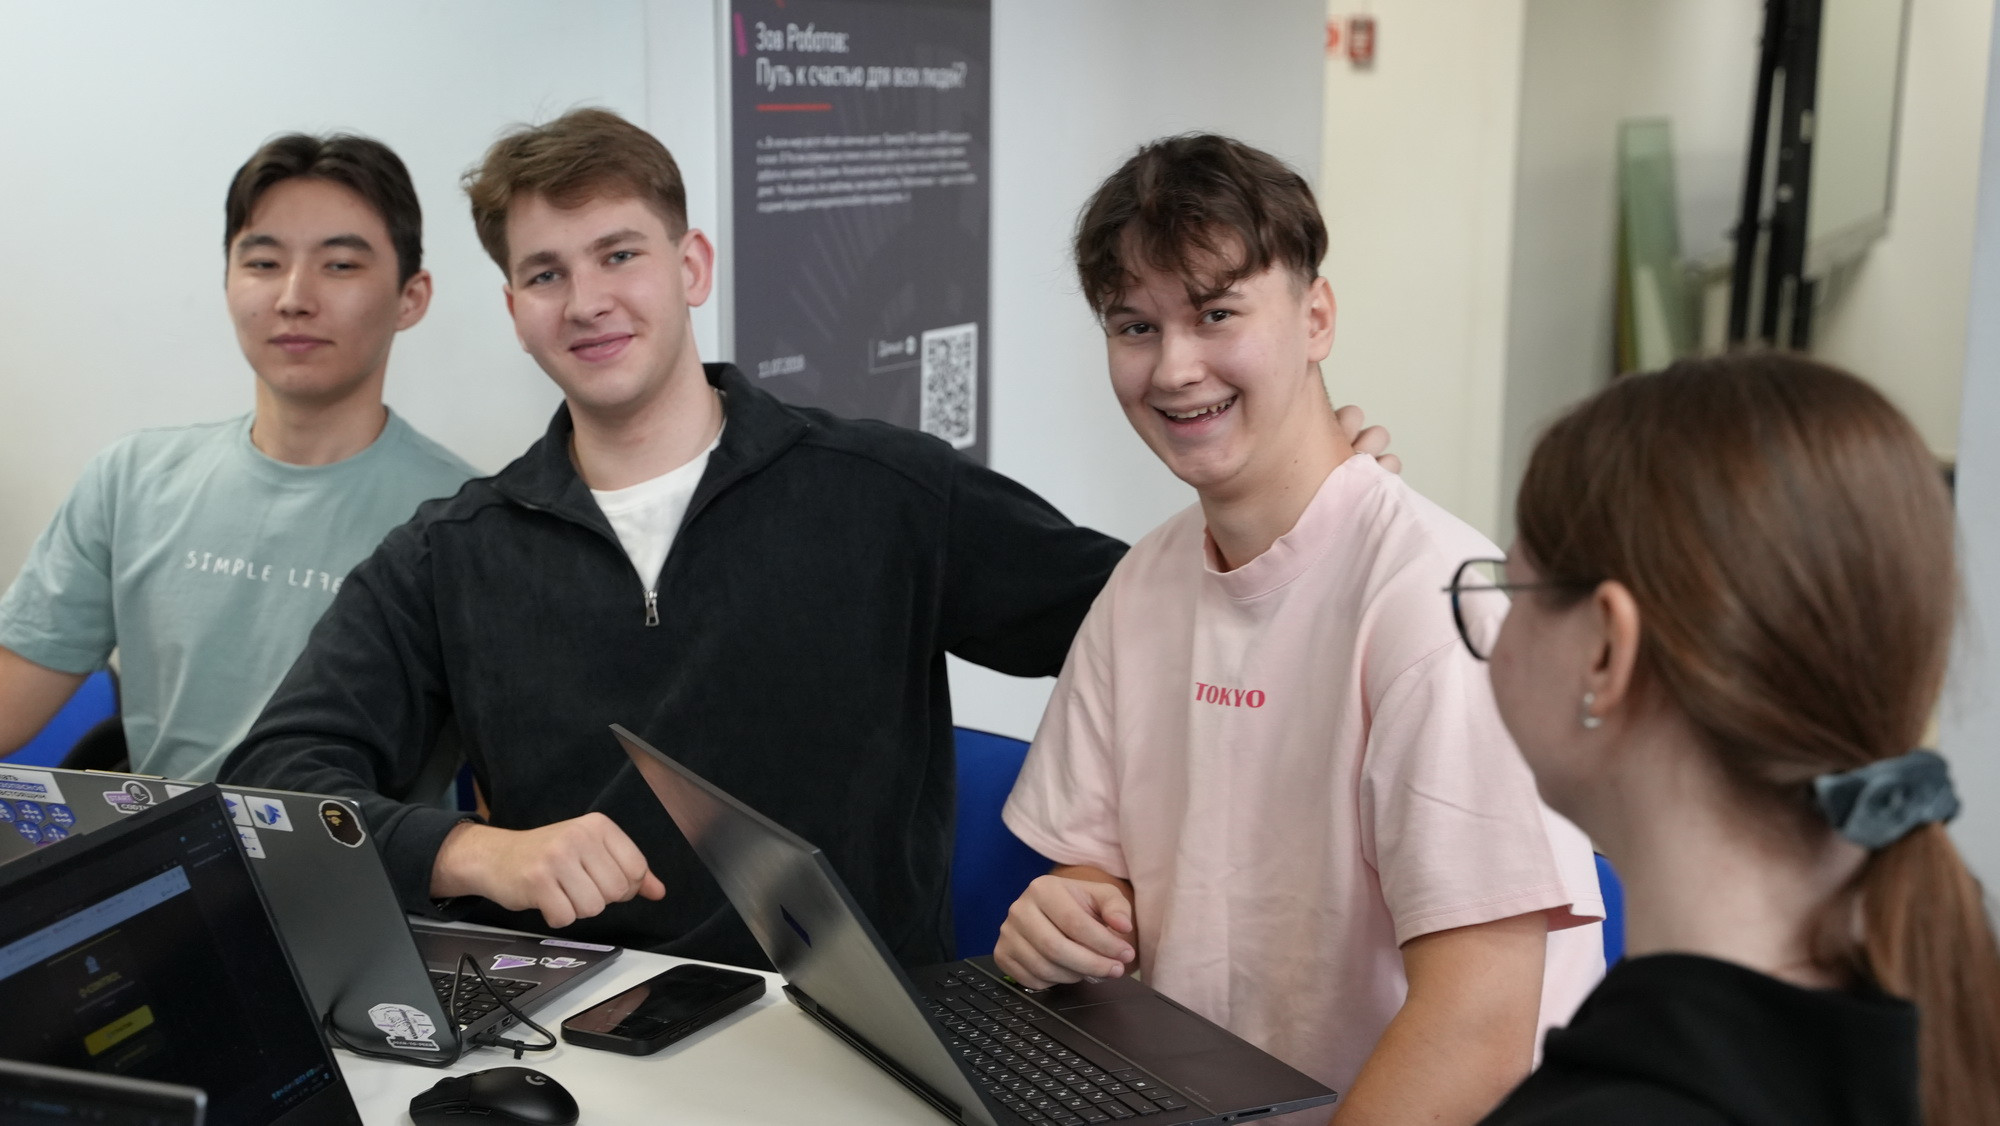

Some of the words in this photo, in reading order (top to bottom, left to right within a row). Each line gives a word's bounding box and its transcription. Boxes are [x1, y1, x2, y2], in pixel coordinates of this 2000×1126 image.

[755, 22, 784, 52] Зов
[787, 22, 850, 53] Роботов:
[755, 57, 794, 92] Путь
[796, 65, 807, 86] к
[808, 64, 863, 88] счастью
[865, 66, 891, 91] для
[892, 66, 919, 88] всех
[184, 550, 274, 583] SIMPLE
[288, 568, 345, 595] LIFE
[1195, 682, 1266, 709] TOKYO
